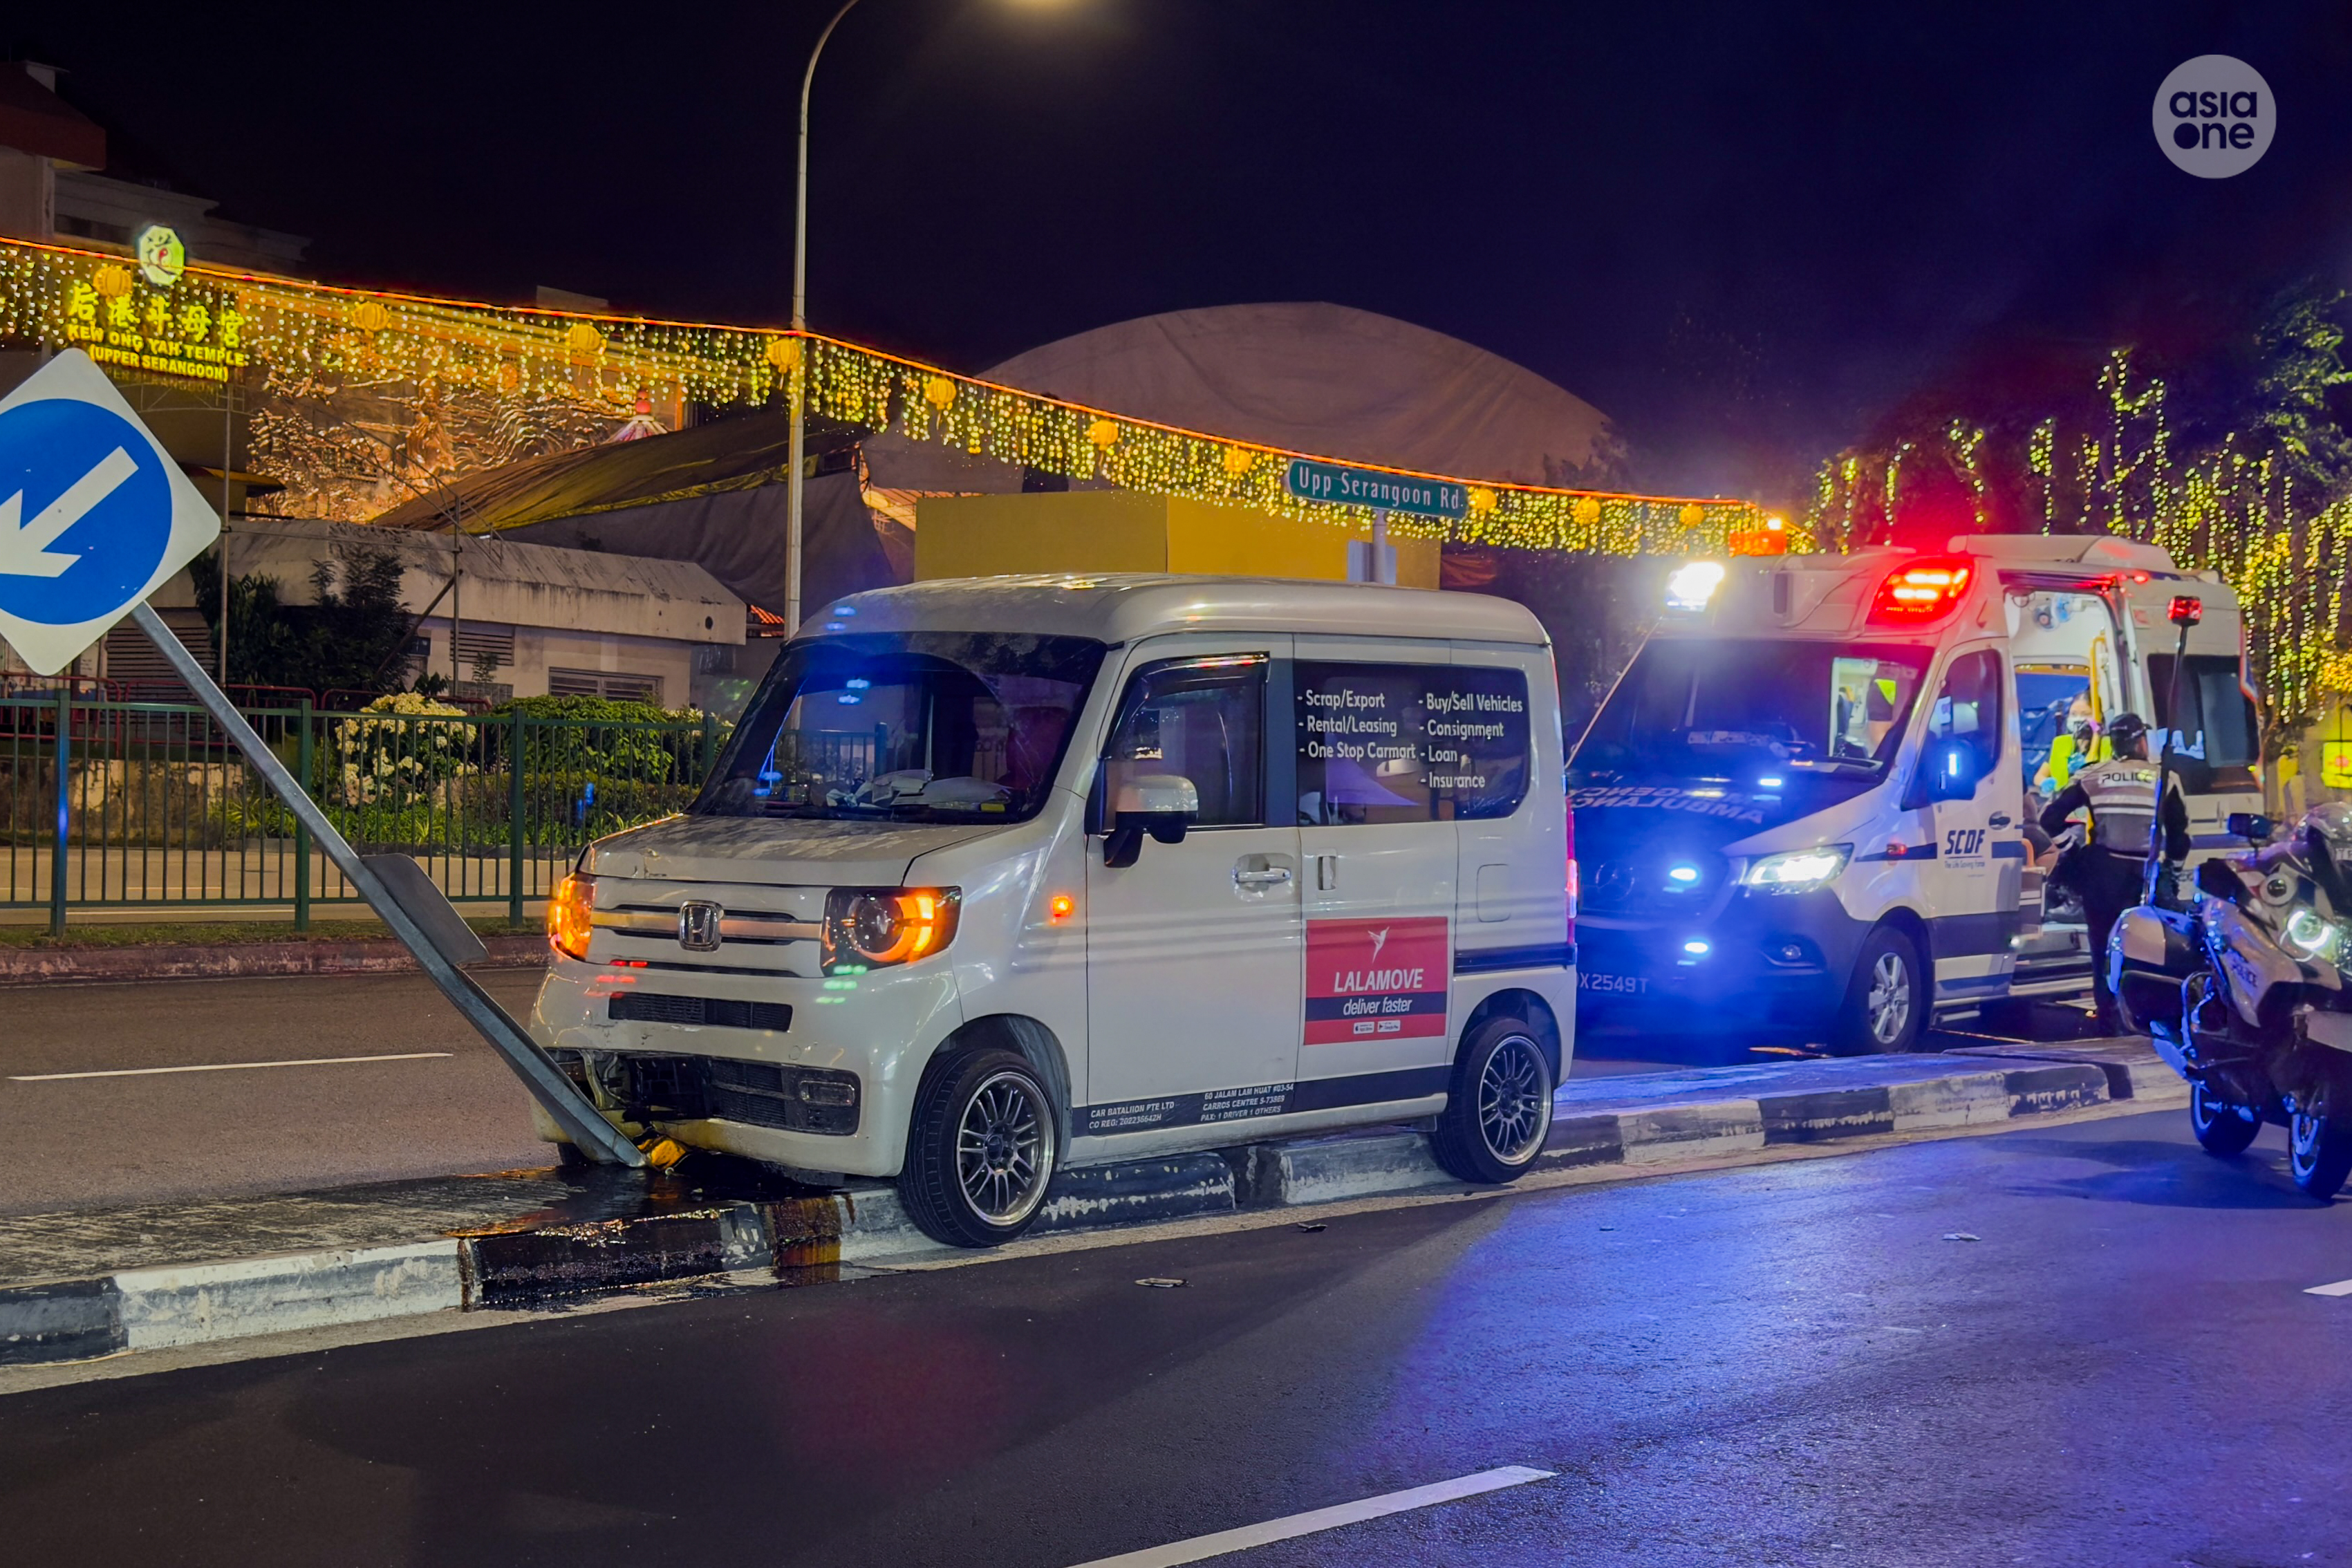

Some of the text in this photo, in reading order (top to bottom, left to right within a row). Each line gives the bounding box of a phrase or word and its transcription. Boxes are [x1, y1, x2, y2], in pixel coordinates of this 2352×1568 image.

[67, 323, 245, 367] KEW ONG YAH TEMPLE
[90, 344, 140, 367] (UPPER
[142, 355, 229, 382] SERANGOON)
[1298, 466, 1459, 510] Upp Serangoon Rd
[1306, 689, 1385, 711] Scrap/Export
[1426, 691, 1474, 714] Buy/Sell
[1476, 694, 1523, 712] Vehicles
[1307, 715, 1397, 737] Rental/Leasing
[1427, 720, 1504, 740] Consignment
[1308, 741, 1334, 758] One
[1336, 743, 1364, 762] Stop
[1368, 743, 1416, 759] Carmart
[1428, 745, 1457, 762] Loan
[1429, 772, 1485, 788] Insurance
[1944, 829, 1986, 855] SCDF
[1334, 969, 1424, 993] LALAMOVE
[1576, 971, 1650, 994] X2549T
[1343, 996, 1412, 1016] deliver faster
[1239, 1088, 1252, 1096] LAM
[1253, 1086, 1271, 1095] HUAT
[1091, 1109, 1105, 1118] CAR
[1146, 1102, 1159, 1111] PTE
[1161, 1101, 1175, 1110] LTD
[1231, 1098, 1258, 1108] CENTRE
[1223, 1109, 1248, 1119] DRIVER
[1089, 1121, 1099, 1129] CO
